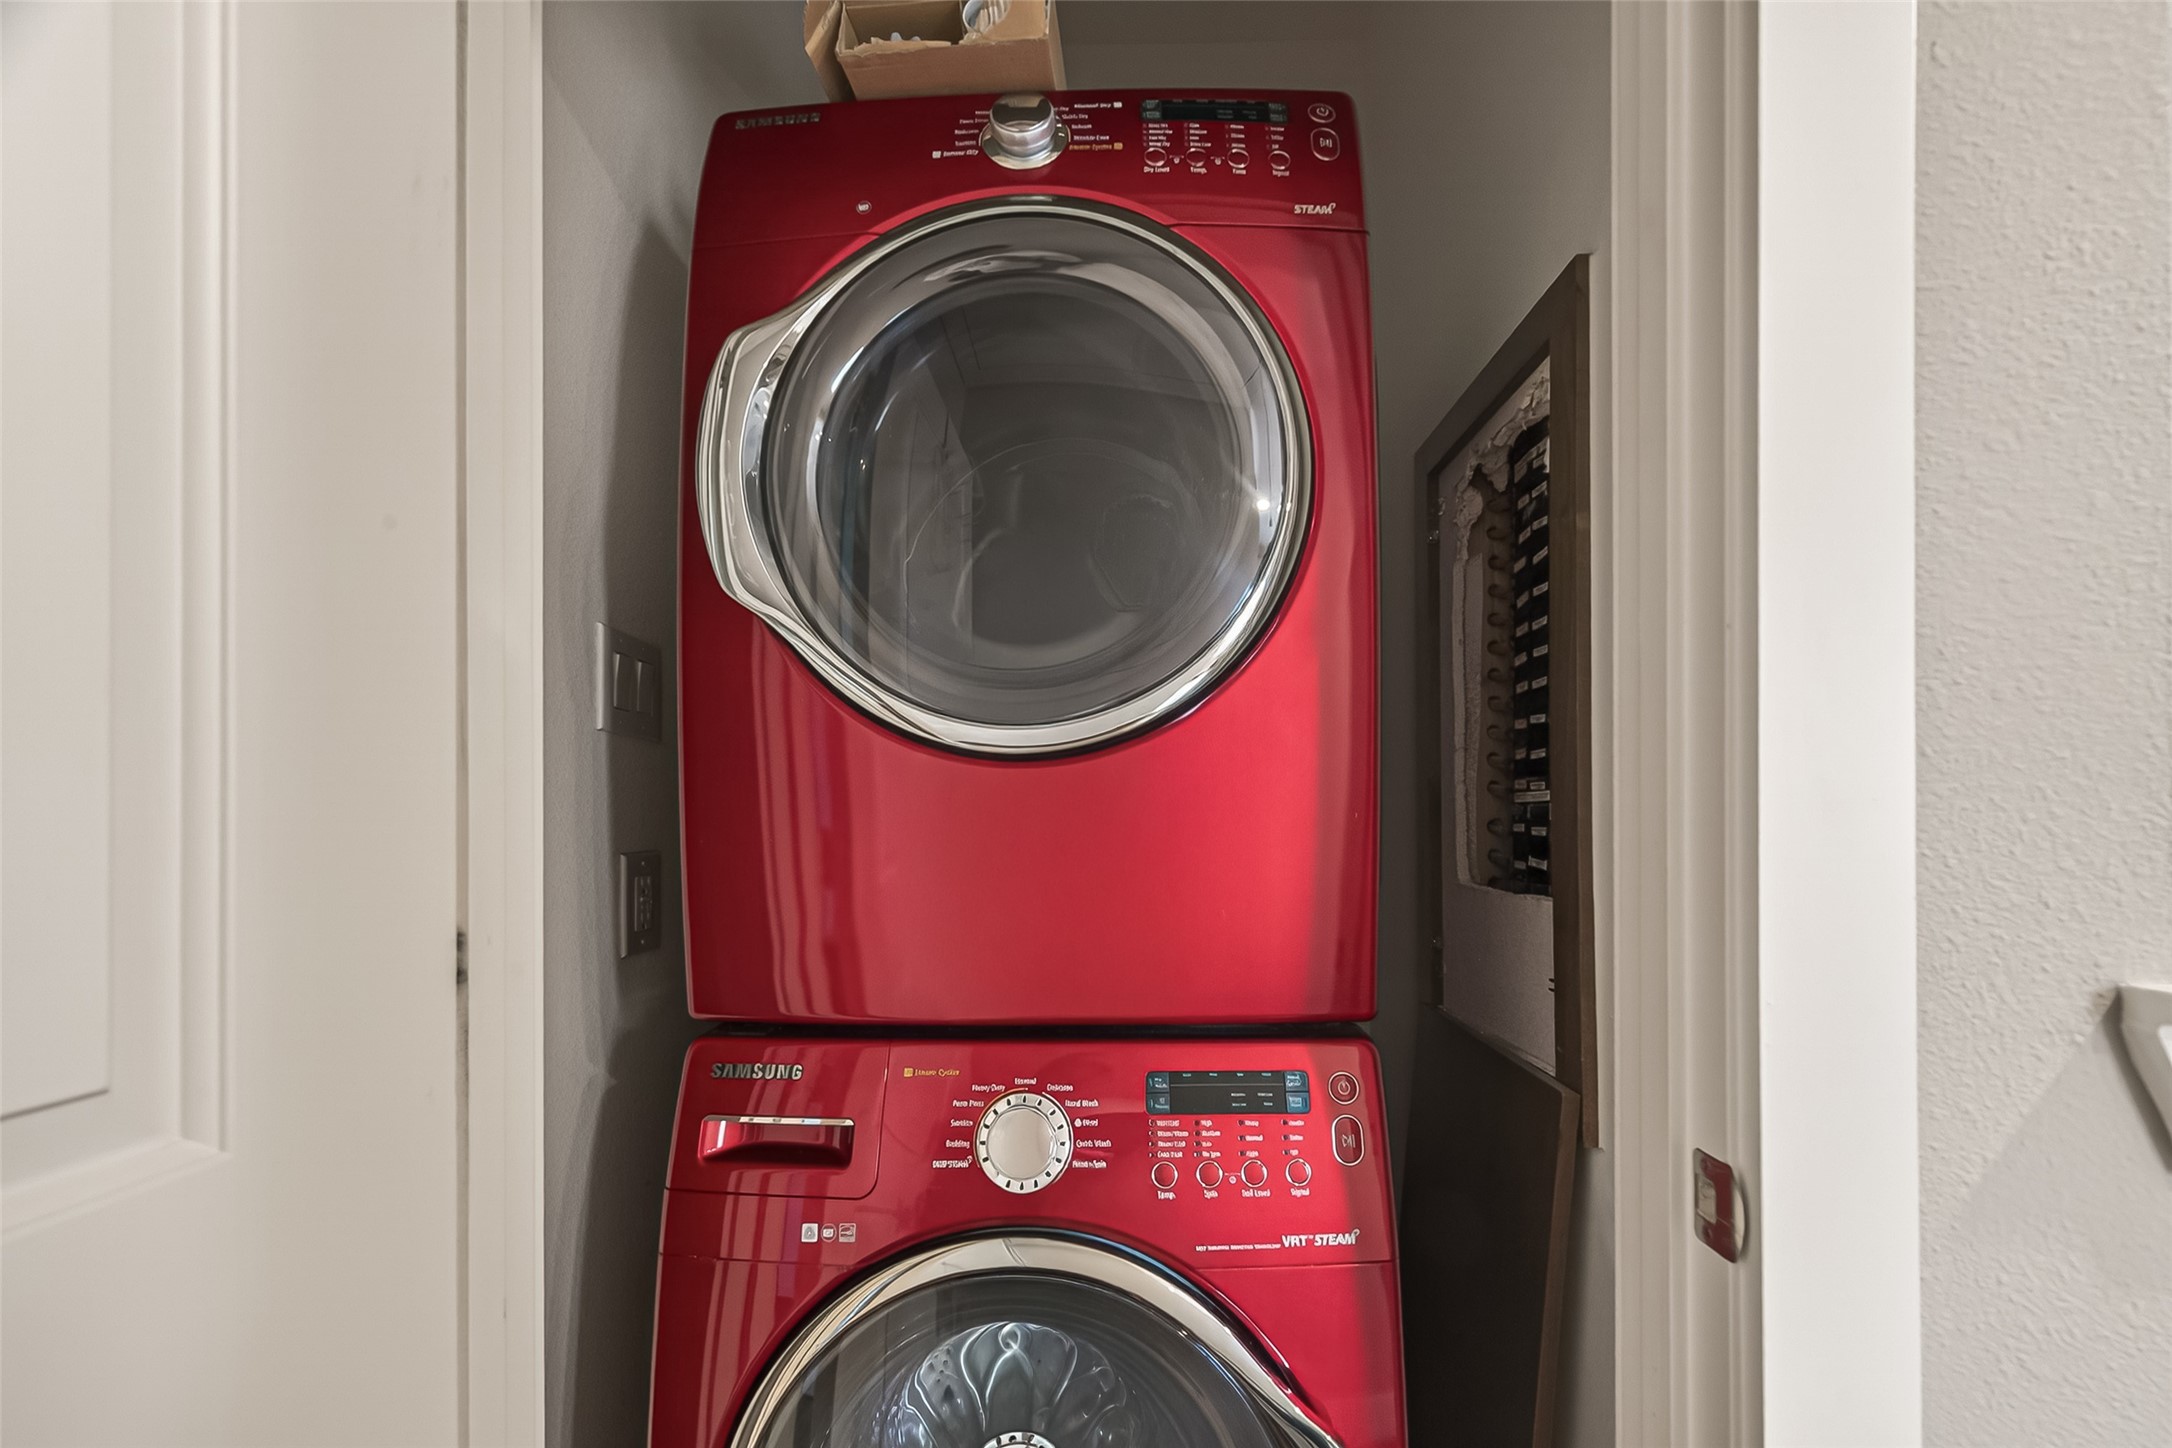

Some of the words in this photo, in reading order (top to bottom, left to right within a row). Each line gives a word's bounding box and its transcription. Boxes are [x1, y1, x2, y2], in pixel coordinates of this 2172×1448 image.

[735, 112, 821, 130] SAMSUNG
[711, 1062, 803, 1081] SAMSUNG
[1314, 1230, 1359, 1246] STEAM
